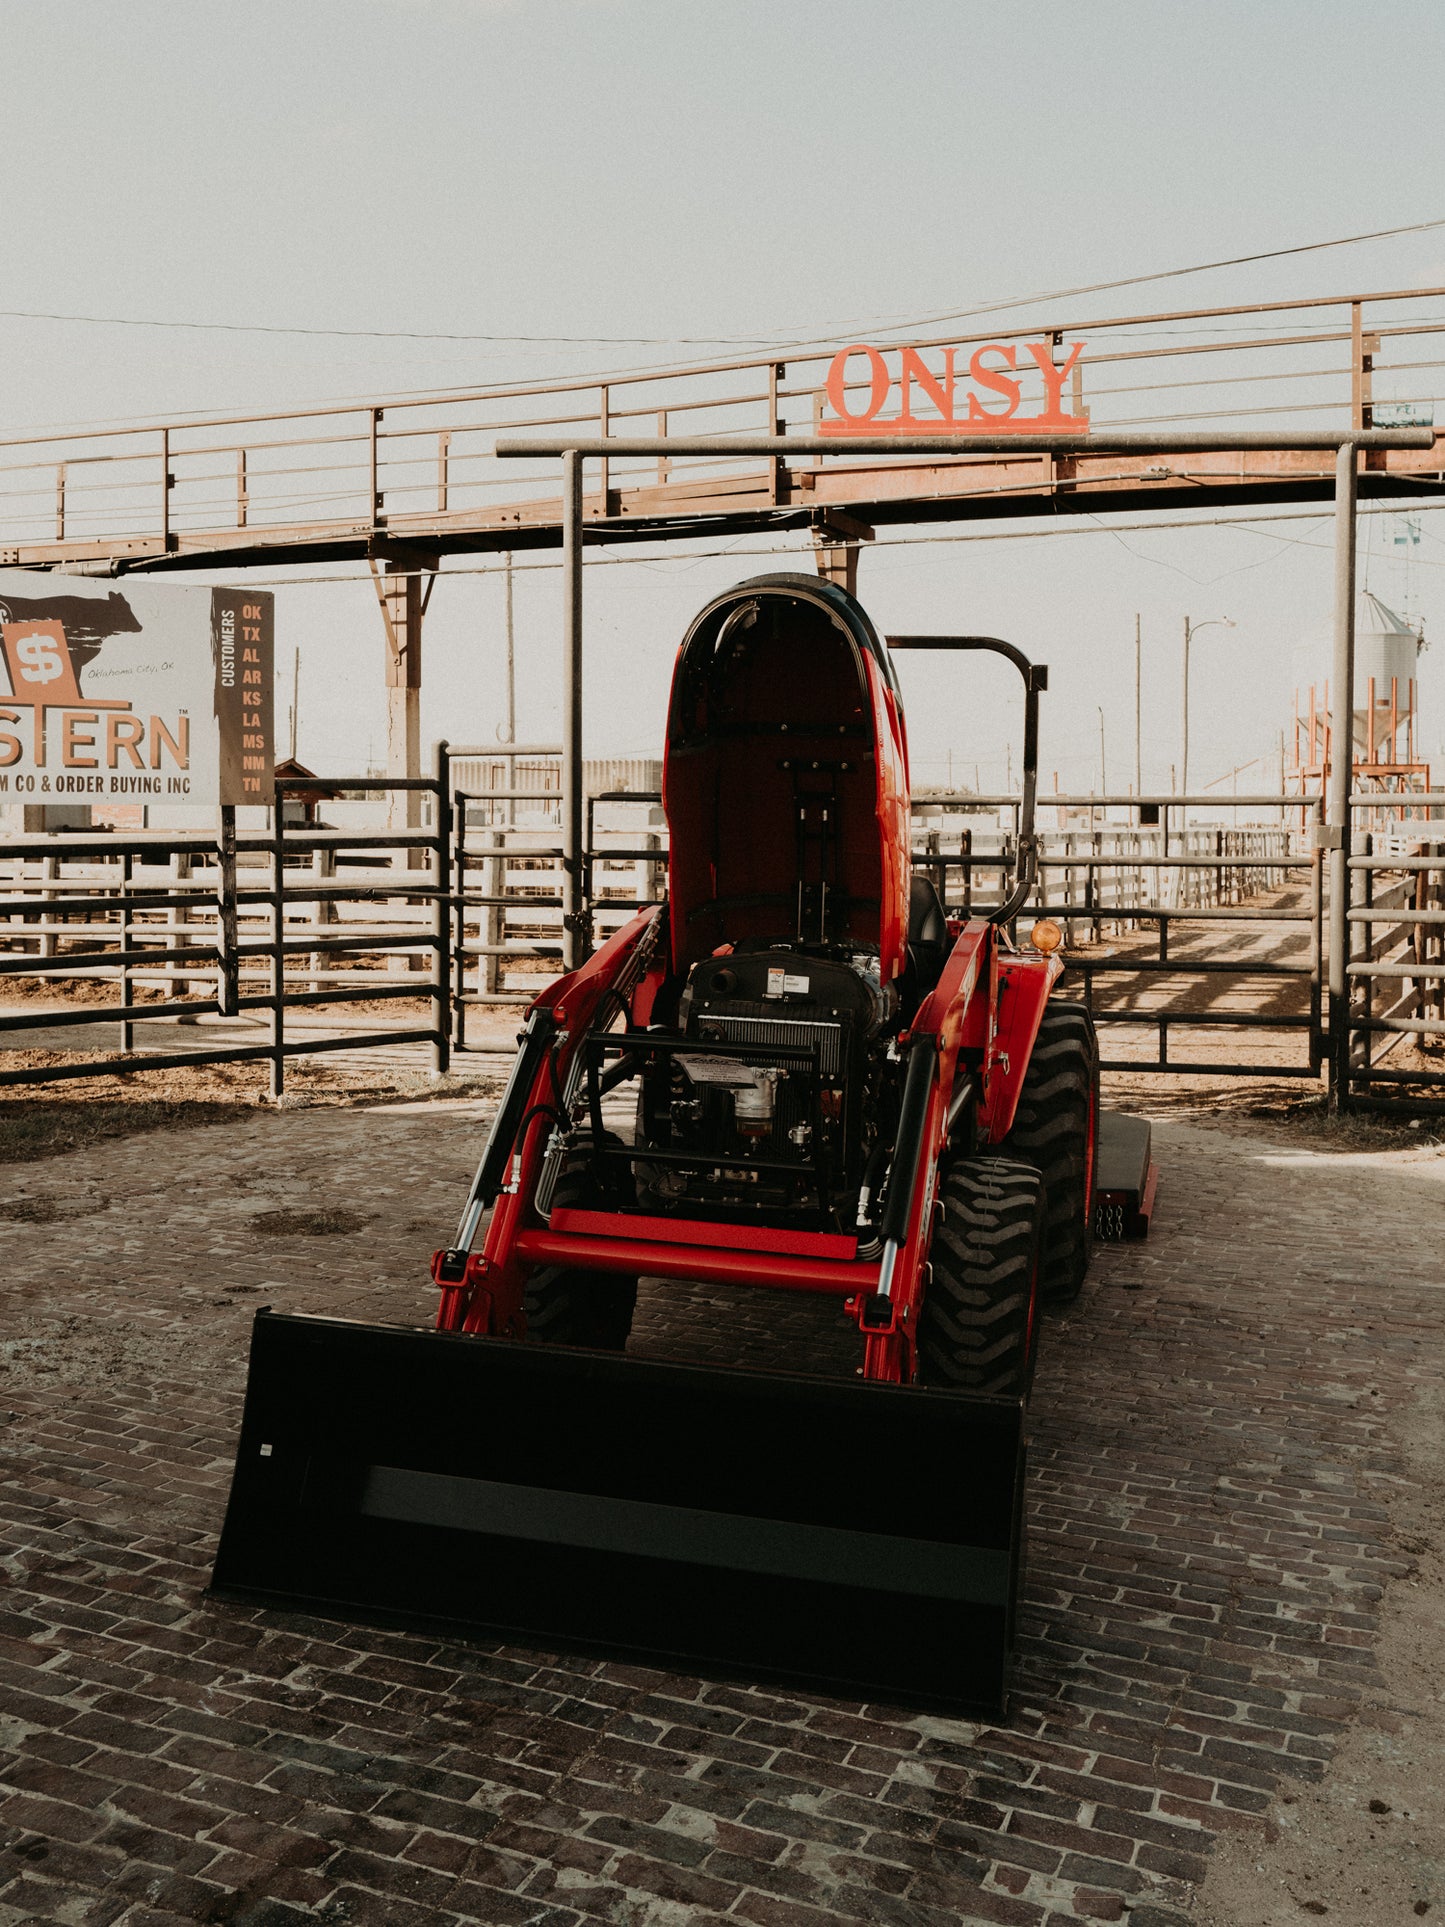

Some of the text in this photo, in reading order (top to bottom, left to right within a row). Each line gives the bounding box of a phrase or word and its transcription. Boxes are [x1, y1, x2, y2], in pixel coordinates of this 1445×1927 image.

[823, 341, 1088, 421] ONSY
[242, 604, 262, 620] OK
[242, 626, 261, 641] TX
[221, 609, 235, 688] CUSTOMERS
[242, 648, 260, 663] AL
[88, 667, 133, 679] Oklahoma
[242, 670, 262, 684] AR
[242, 691, 262, 706] KS
[242, 713, 261, 727] LA
[242, 734, 265, 749] MS
[242, 756, 265, 770] NM
[15, 775, 36, 792] CO
[41, 775, 51, 792] &
[55, 775, 104, 793] ORDER
[110, 776, 161, 793] BUYING
[167, 777, 190, 794] INC
[242, 777, 261, 792] TN
